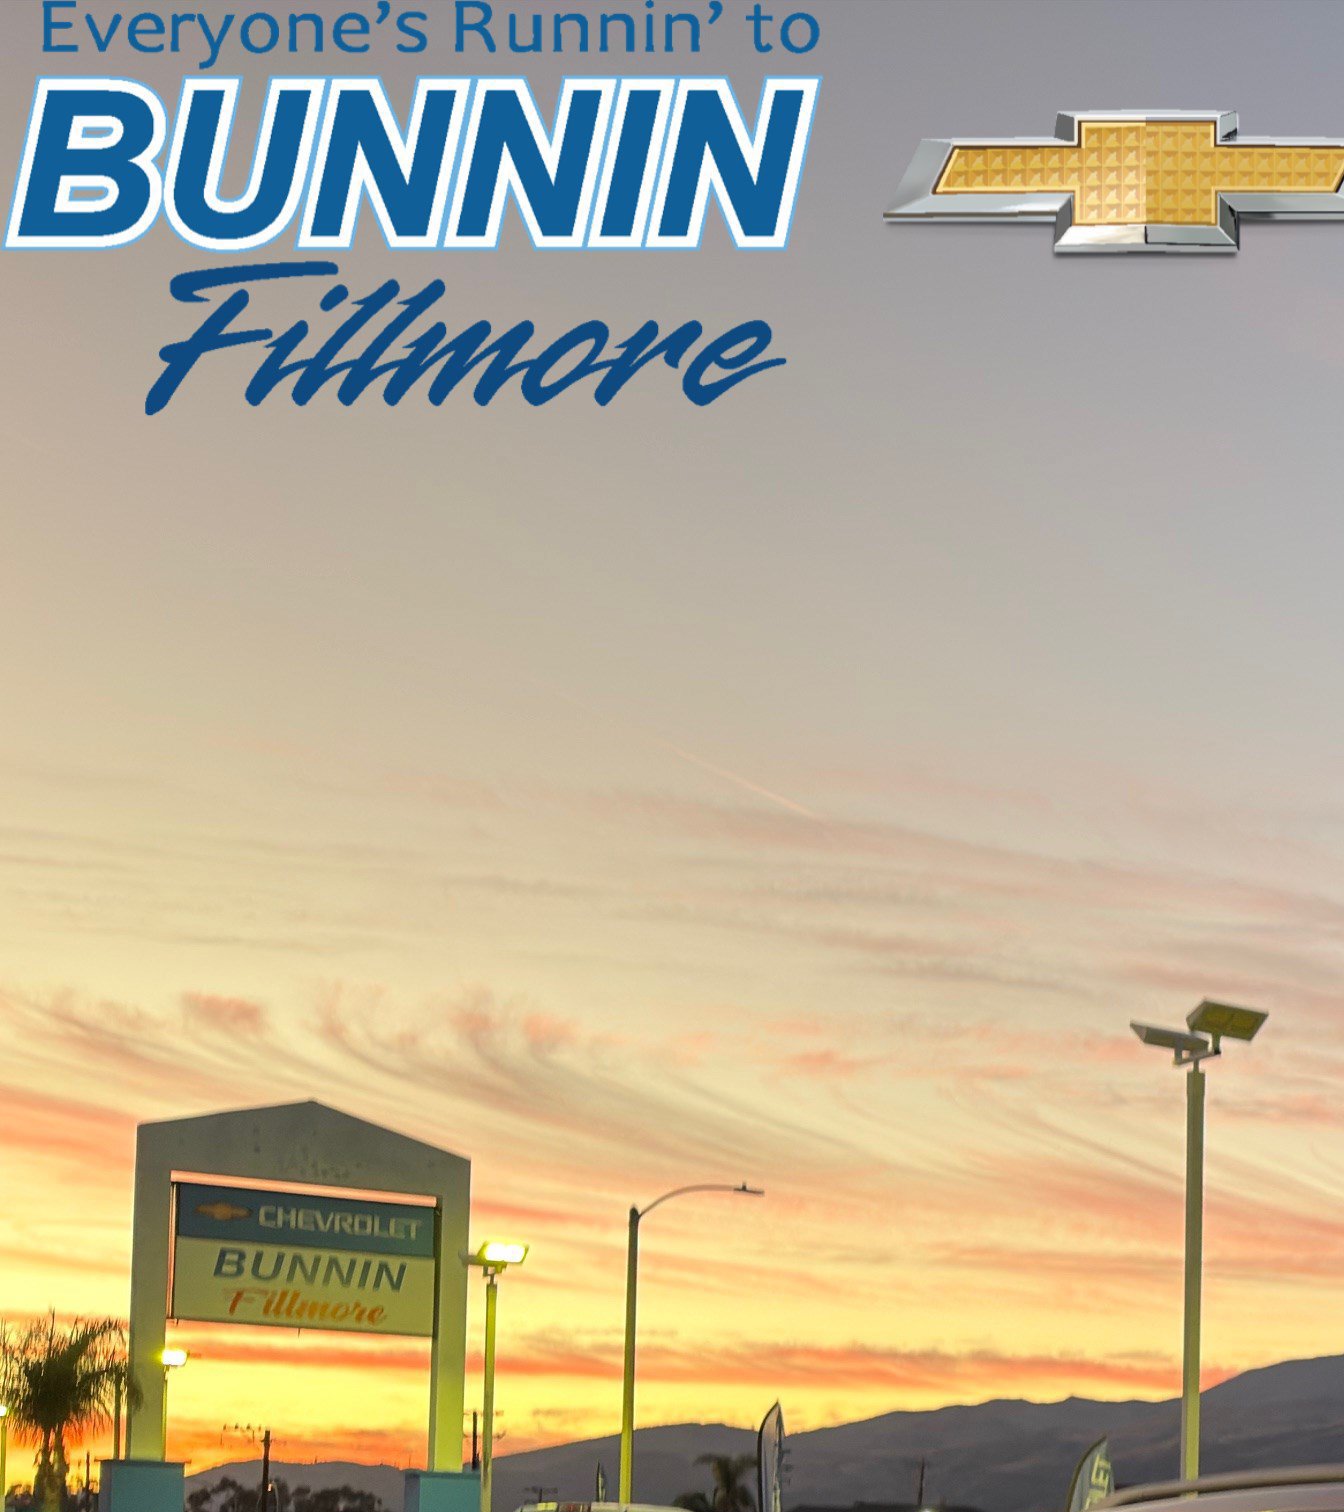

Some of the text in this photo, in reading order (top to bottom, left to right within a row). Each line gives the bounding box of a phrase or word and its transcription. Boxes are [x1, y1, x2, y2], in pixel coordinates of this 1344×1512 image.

[259, 1204, 422, 1241] CHEVROLET
[212, 1246, 408, 1293] BUNNIN
[221, 1286, 389, 1327] Fillmore
